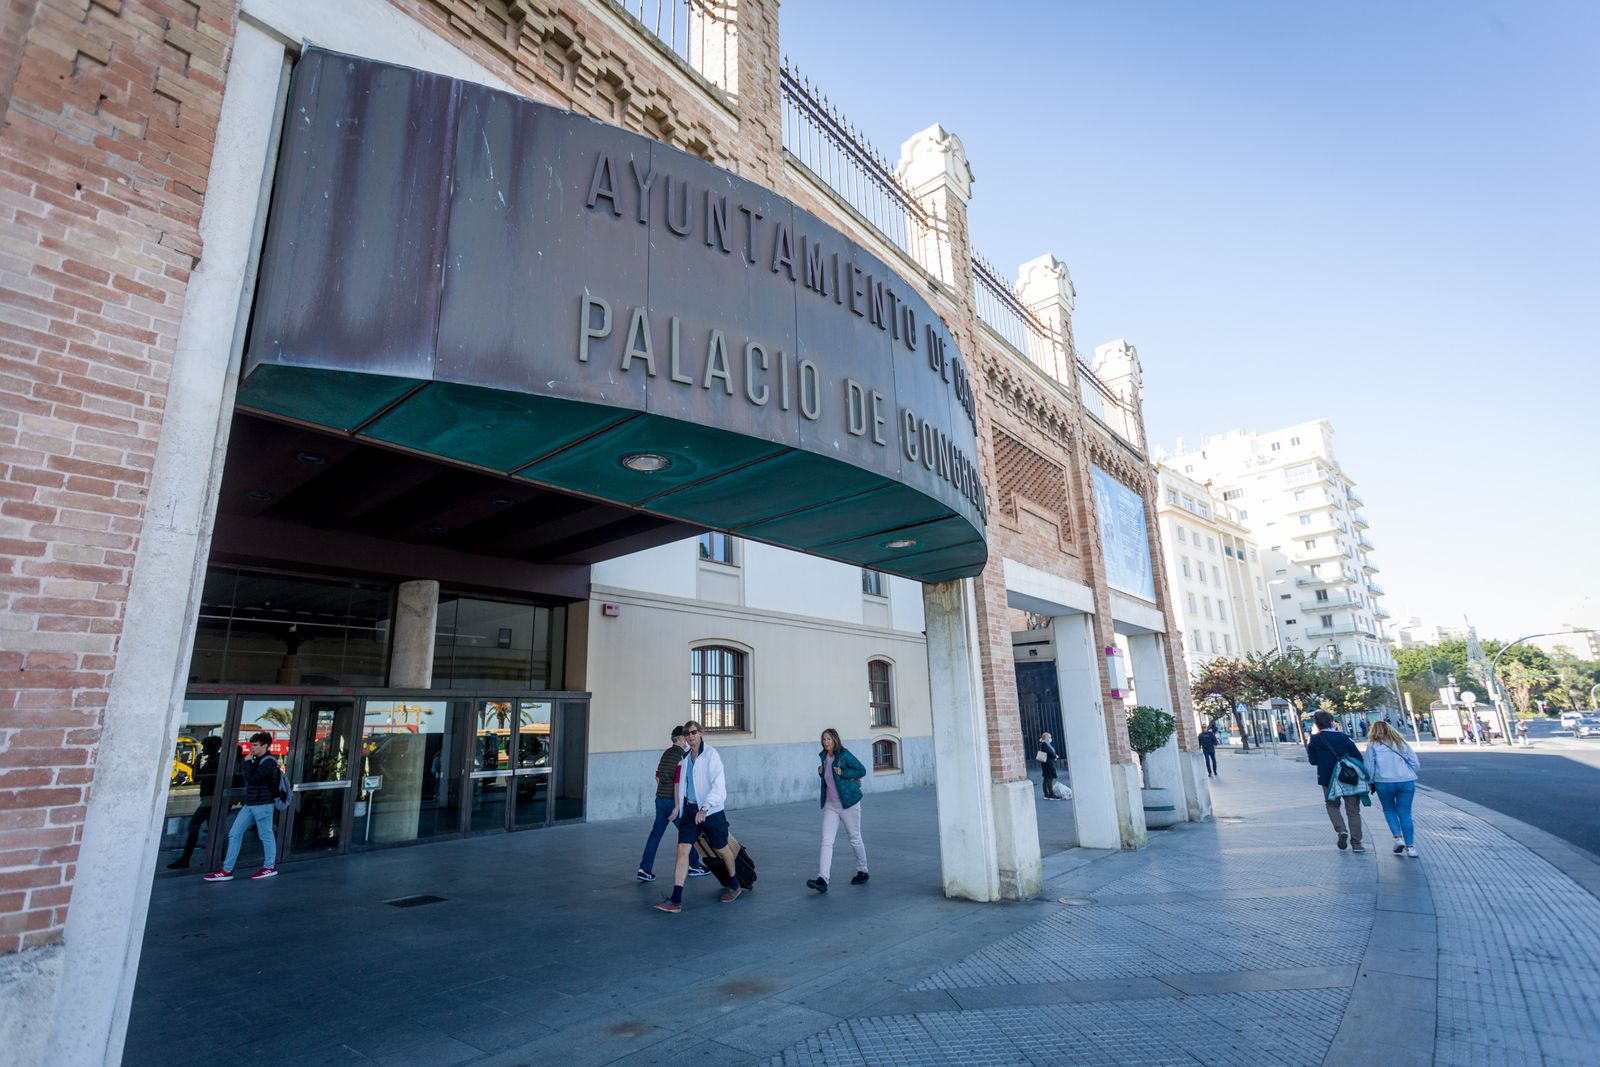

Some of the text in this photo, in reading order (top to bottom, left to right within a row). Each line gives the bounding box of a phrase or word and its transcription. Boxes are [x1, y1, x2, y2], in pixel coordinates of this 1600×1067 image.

[586, 151, 917, 351] AYUNTAMIENTO
[926, 323, 950, 385] DE
[579, 293, 821, 421] PALACIO
[843, 378, 886, 446] DE
